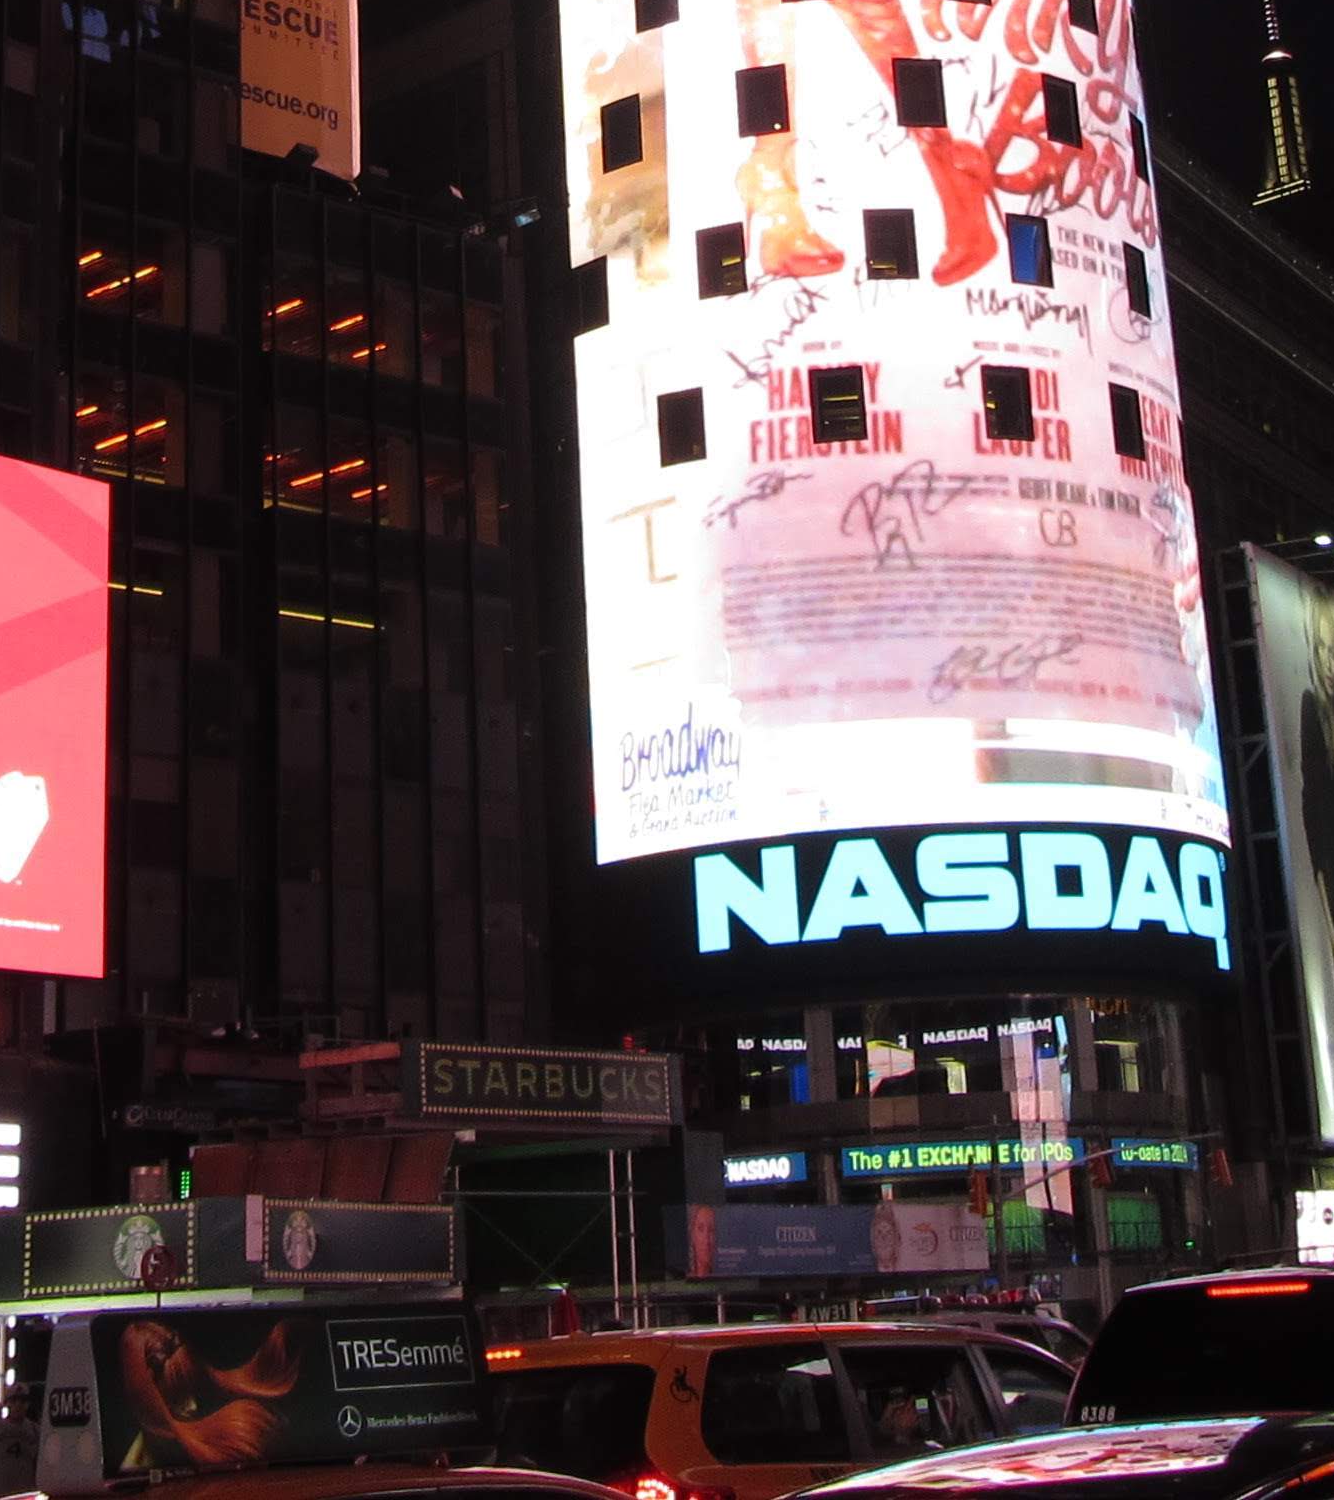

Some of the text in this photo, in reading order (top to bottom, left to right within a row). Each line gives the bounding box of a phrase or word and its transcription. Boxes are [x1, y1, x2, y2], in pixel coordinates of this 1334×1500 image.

[767, 361, 882, 413] HAY
[618, 702, 741, 793] Broadway
[665, 780, 736, 806] Market
[693, 831, 1231, 971] NASDAQ
[922, 1026, 989, 1046] NASDAQ
[432, 1056, 664, 1103] STARBUCKS
[726, 1156, 791, 1183] NASDAQ
[848, 1146, 883, 1172] The
[886, 1143, 913, 1170] #1
[1013, 1142, 1038, 1164] for
[776, 1226, 818, 1243] CITIZEN
[336, 1335, 465, 1371] TRESemmé
